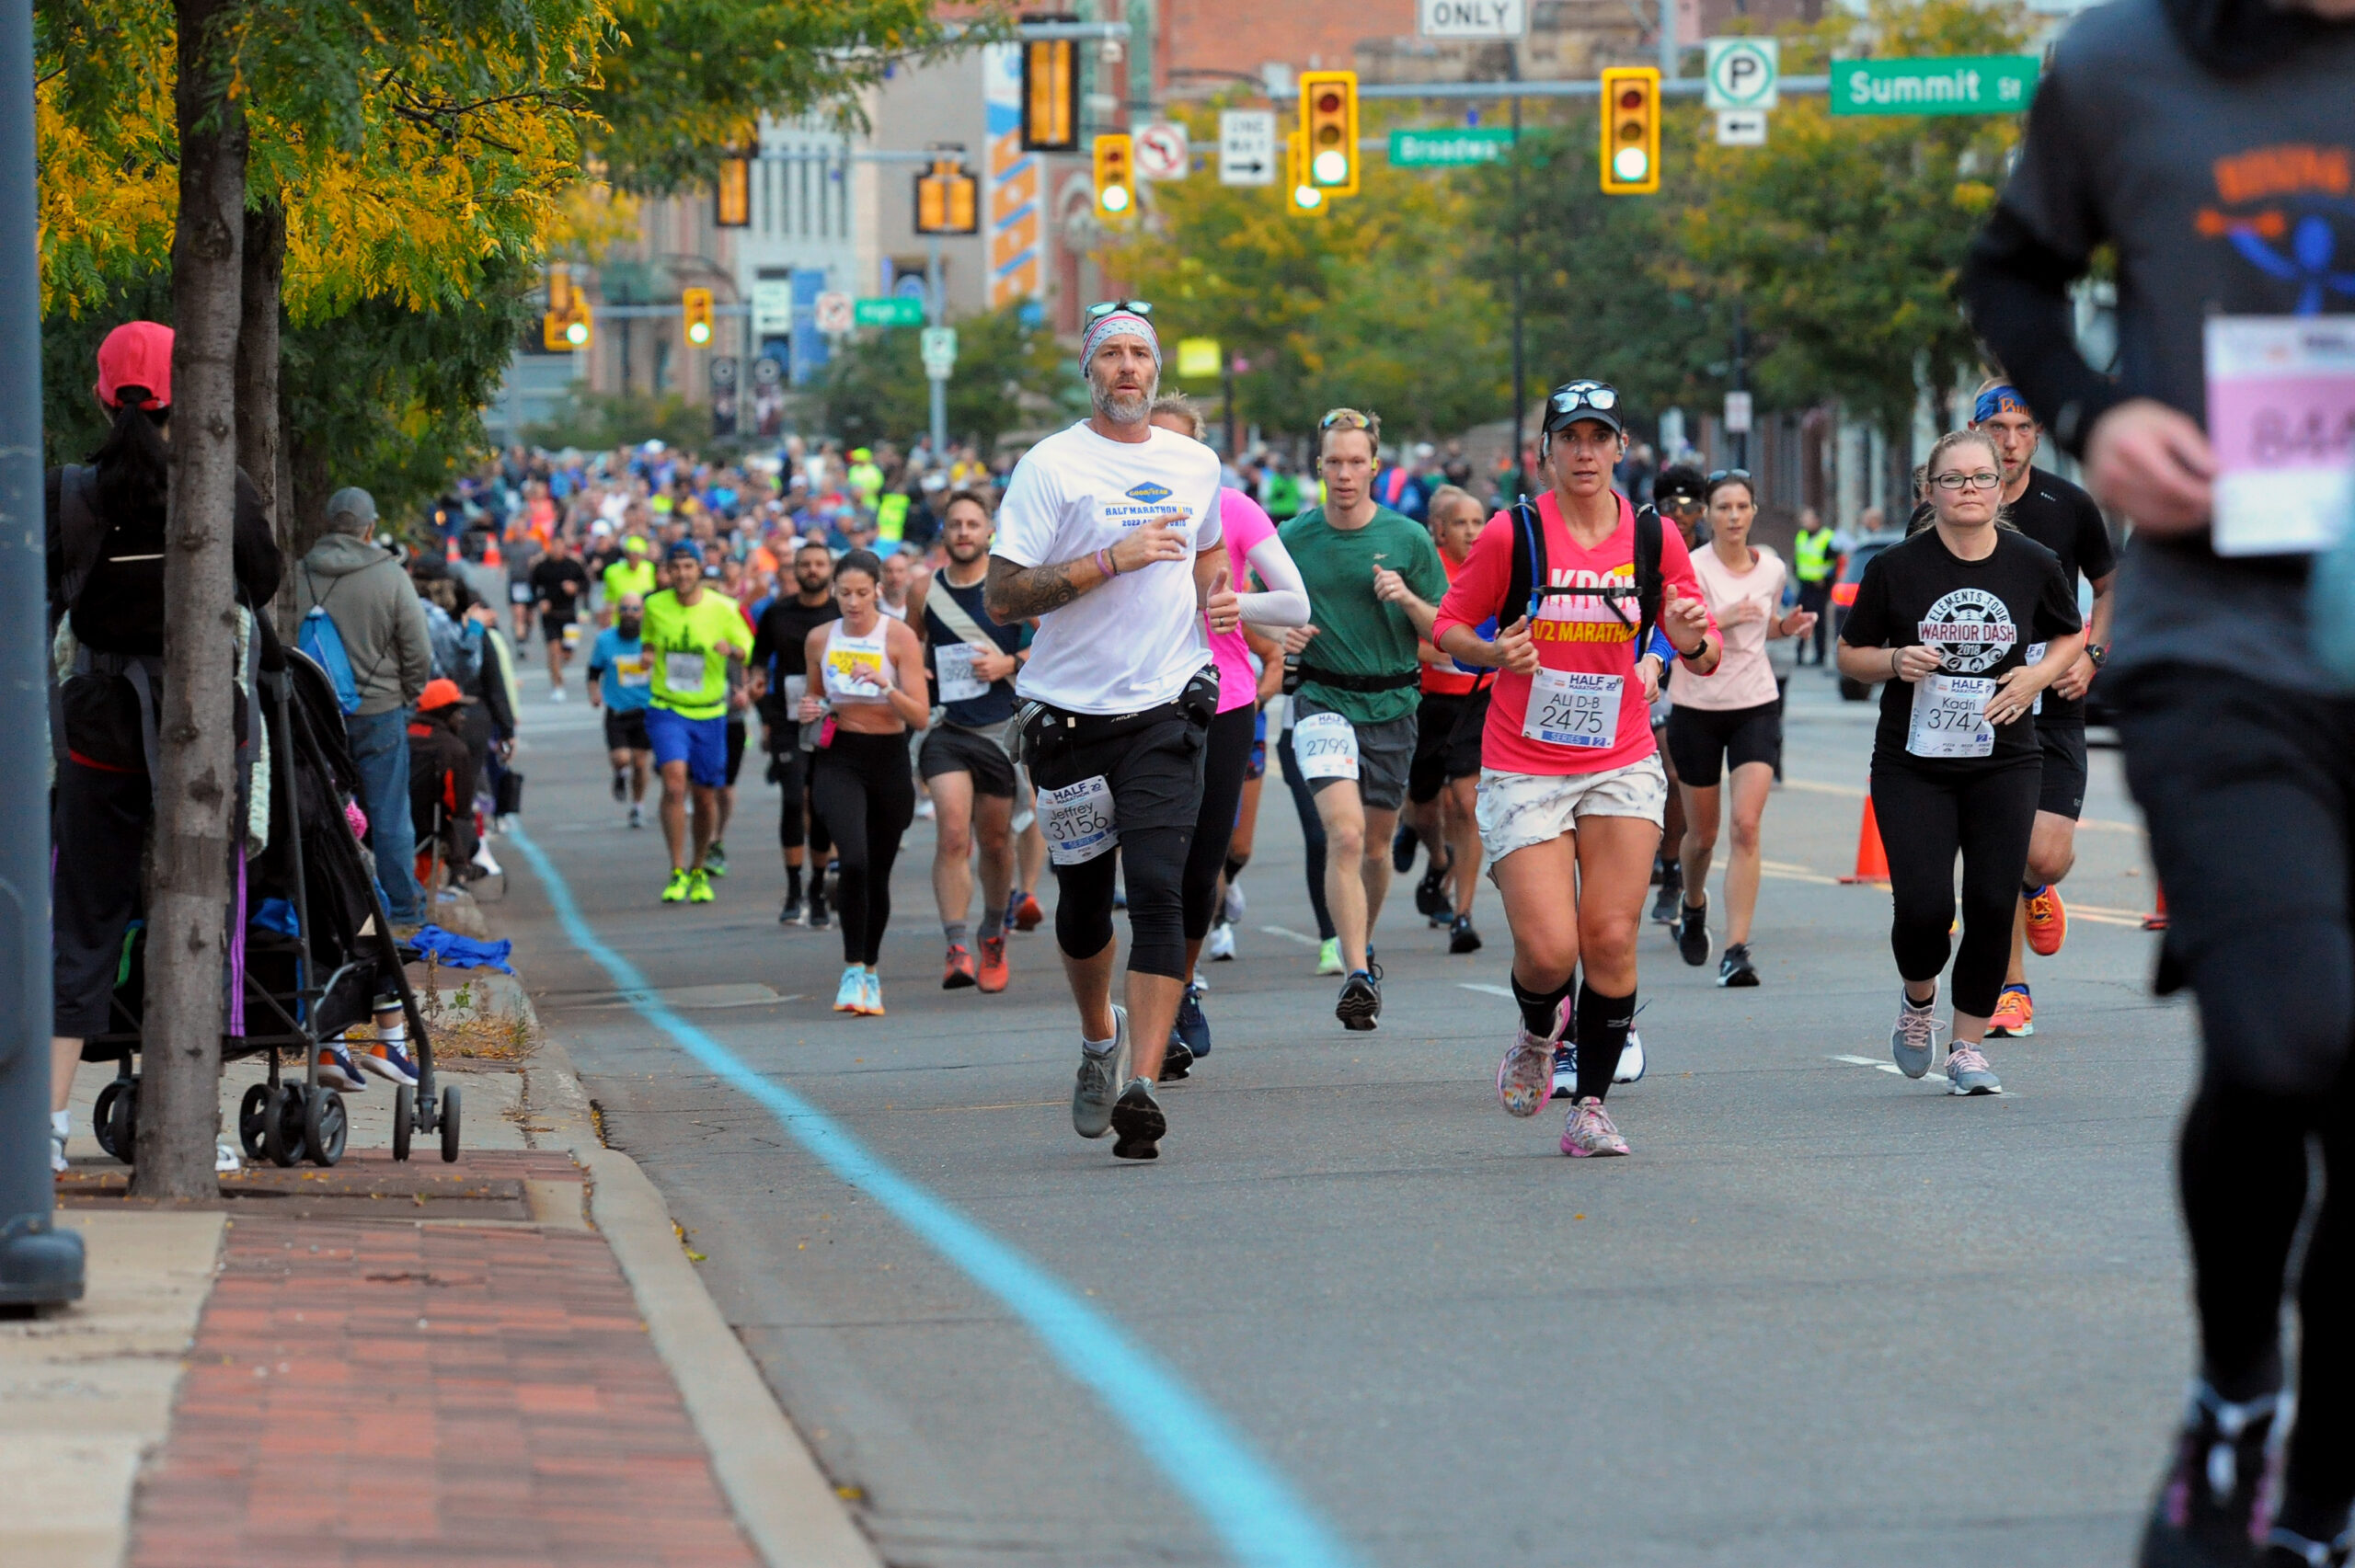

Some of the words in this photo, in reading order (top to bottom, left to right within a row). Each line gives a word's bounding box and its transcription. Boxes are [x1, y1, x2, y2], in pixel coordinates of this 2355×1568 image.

[1434, 2, 1508, 28] ONLY
[1730, 57, 1756, 90] P
[1850, 70, 1981, 105] Summit
[1997, 76, 2022, 102] St
[1401, 136, 1499, 161] Broadwa
[1106, 507, 1128, 515] HALF
[1130, 506, 1177, 515] MARATHON
[1929, 591, 1982, 622] ELEMENTS
[1985, 597, 2007, 623] TOUR
[1921, 624, 1979, 641] WARRIOR
[1982, 625, 2015, 642] DASH
[1957, 644, 1981, 656] 2018
[1569, 674, 1604, 685] HALF
[1952, 680, 1984, 689] HALF
[1550, 693, 1572, 707] ALI
[1576, 696, 1600, 709] D-B
[1942, 697, 1976, 711] Kadri
[1540, 705, 1603, 734] 2475
[1927, 708, 1985, 732] 3747
[1307, 738, 1350, 756] 2799
[1551, 732, 1581, 744] SERIES
[1053, 783, 1086, 800] HALF
[1057, 791, 1090, 804] MARATHON
[1051, 802, 1093, 820] Jeffrey
[1050, 811, 1108, 841] 3156
